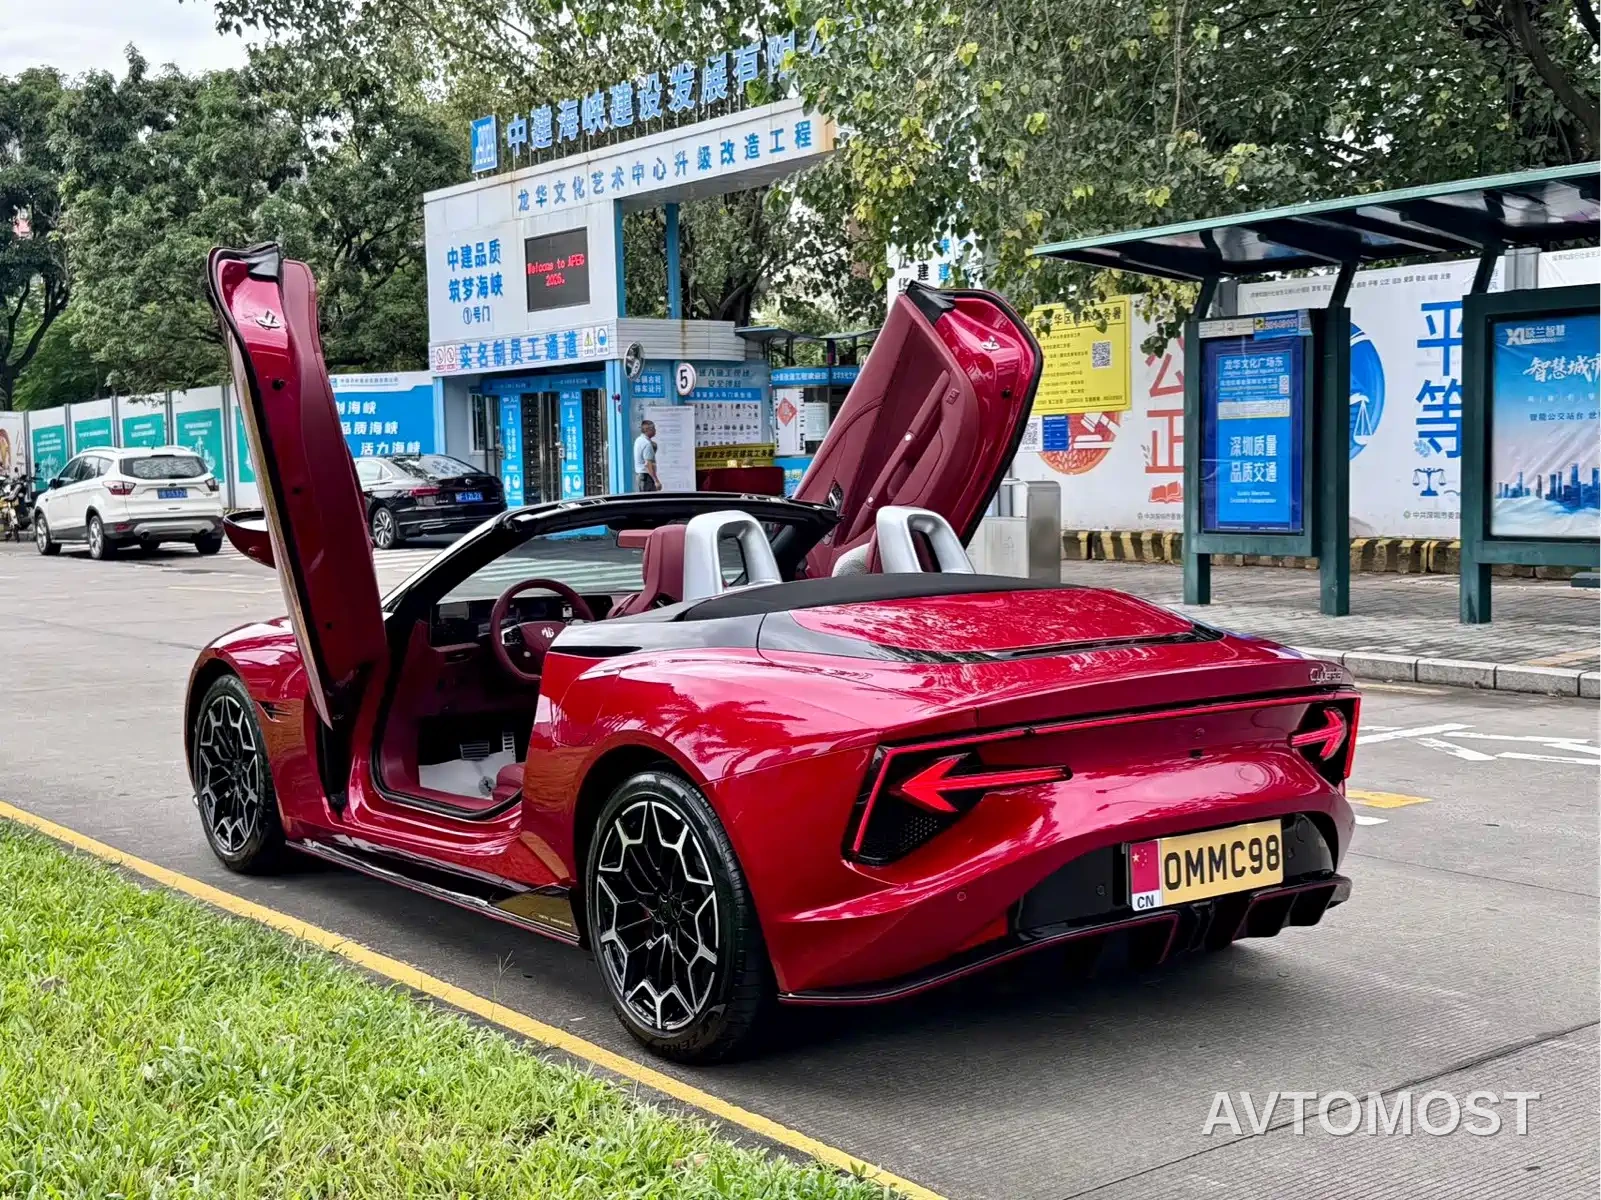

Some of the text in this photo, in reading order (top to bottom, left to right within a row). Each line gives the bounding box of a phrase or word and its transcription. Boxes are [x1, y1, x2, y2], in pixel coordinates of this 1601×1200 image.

[518, 119, 812, 212] 龙华文化艺术中心升级改造工程
[447, 238, 502, 272] 中建品质
[527, 261, 553, 275] Welcome
[557, 258, 565, 269] to
[448, 272, 503, 303] 筑梦海峡
[459, 330, 578, 370] 实名制员工通道
[1224, 356, 1283, 370] 龙华文化广场东
[680, 369, 688, 389] 5
[1415, 300, 1462, 458] 平等
[342, 421, 399, 435] 品质海峡
[360, 440, 421, 456] 活力海峡
[1229, 434, 1278, 457] 深圳质量
[1229, 461, 1277, 483] 品质交通
[541, 626, 555, 638] MG
[1137, 895, 1154, 909] CN
